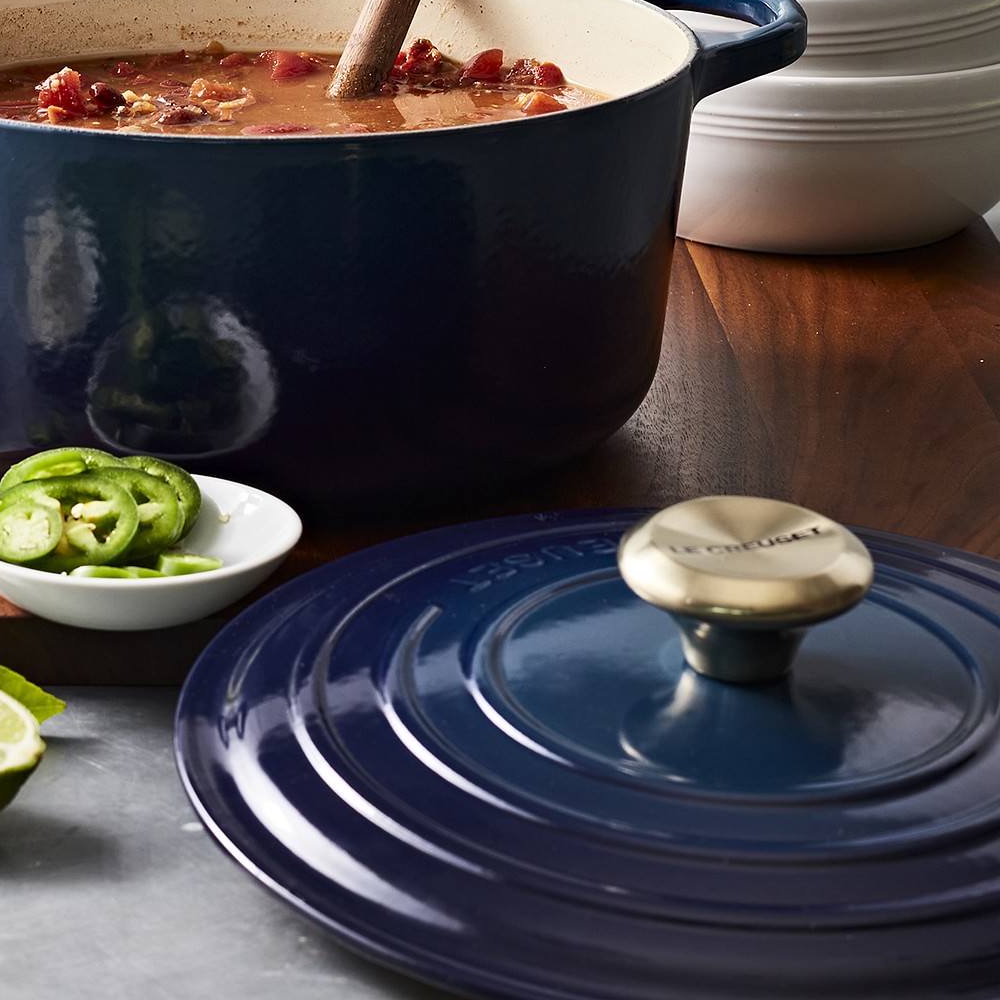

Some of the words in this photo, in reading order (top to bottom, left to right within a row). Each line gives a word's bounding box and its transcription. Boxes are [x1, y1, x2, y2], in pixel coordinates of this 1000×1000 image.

[668, 545, 700, 554] LE
[706, 526, 821, 555] CREUSET
[449, 538, 618, 593] EUSET
